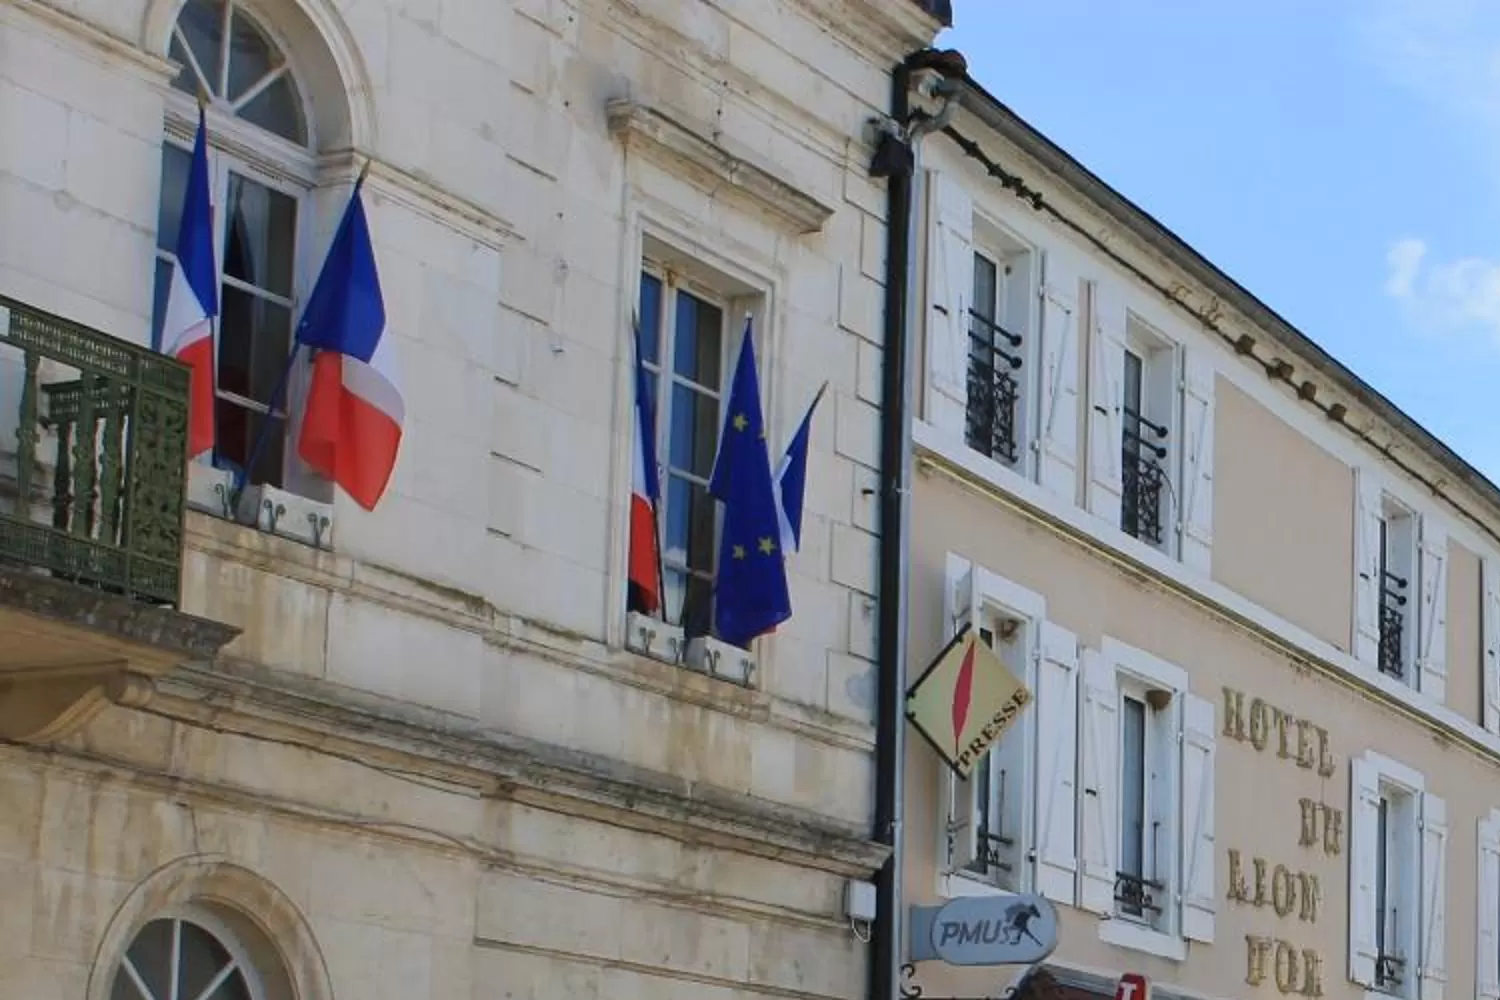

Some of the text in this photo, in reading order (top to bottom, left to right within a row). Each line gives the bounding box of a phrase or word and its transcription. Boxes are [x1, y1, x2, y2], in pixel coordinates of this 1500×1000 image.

[960, 685, 1029, 768] PRESSE
[1222, 686, 1335, 777] HOTEL
[1299, 798, 1343, 855] DU
[1227, 848, 1320, 924] LION
[939, 919, 1002, 947] PMU
